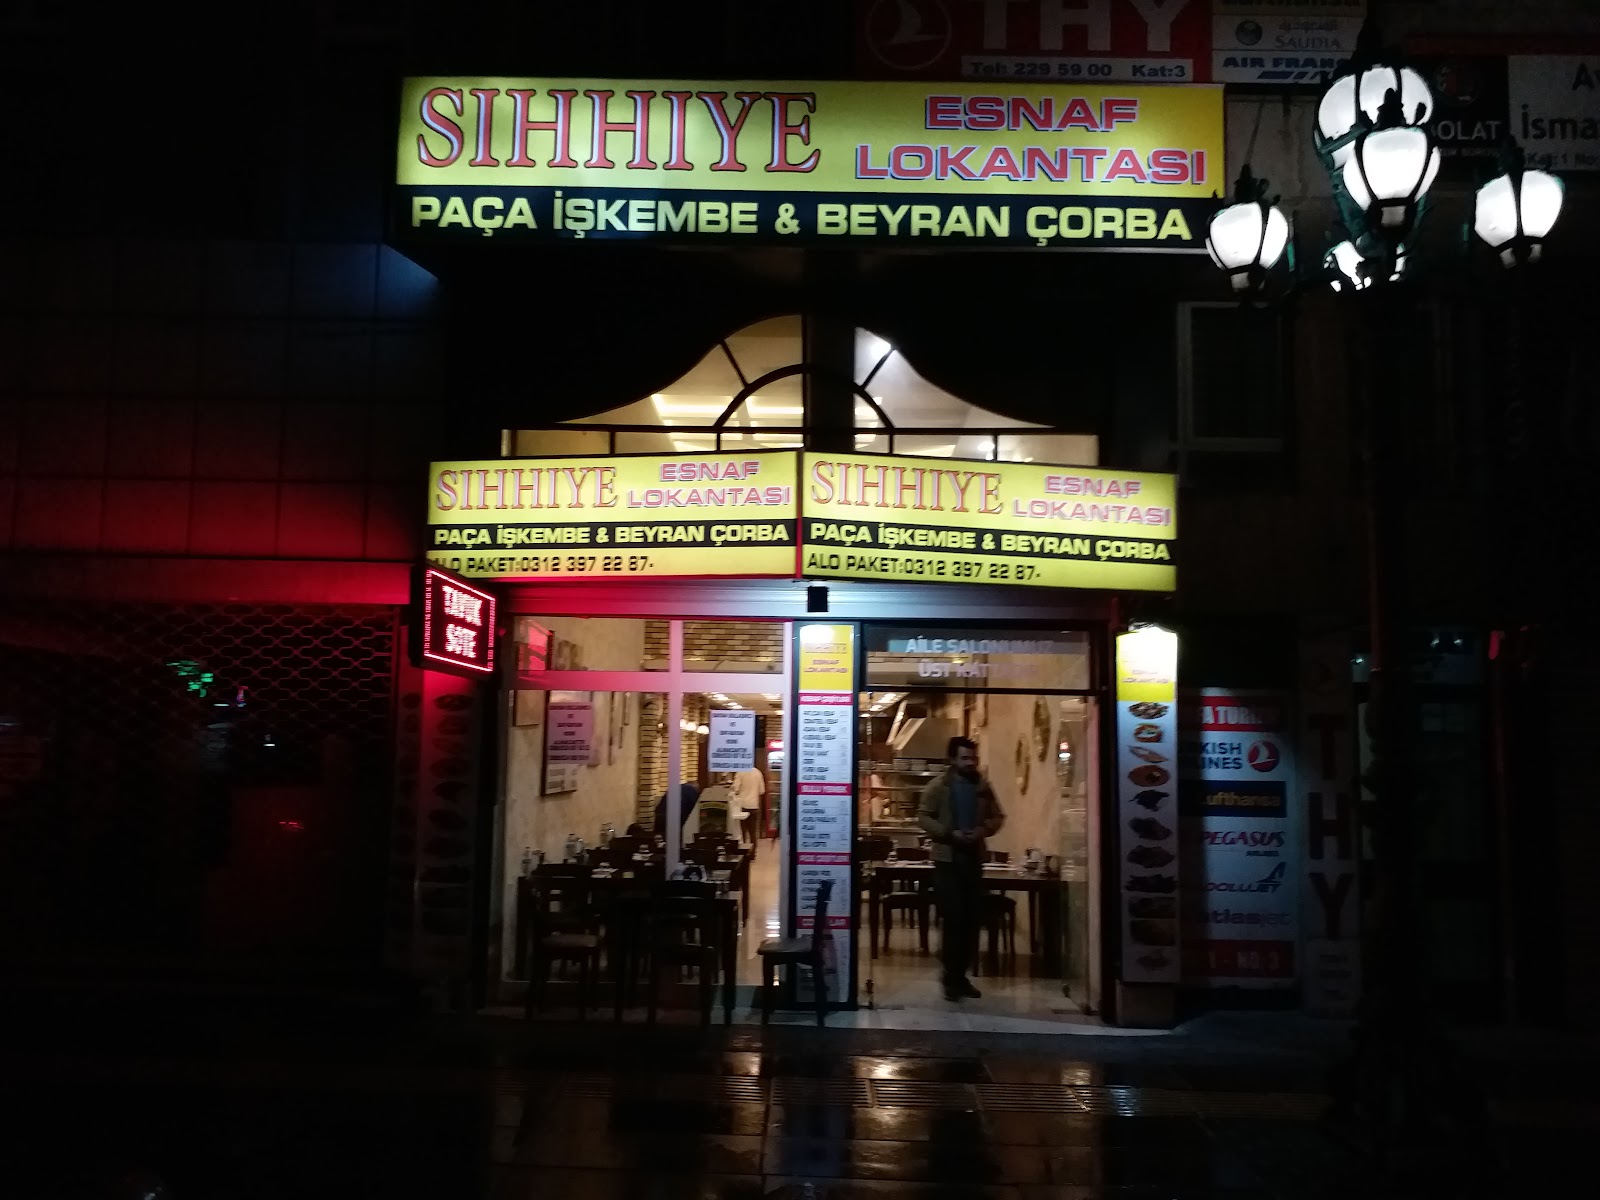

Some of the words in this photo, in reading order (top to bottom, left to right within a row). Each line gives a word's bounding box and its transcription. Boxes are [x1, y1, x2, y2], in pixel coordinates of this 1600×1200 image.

[968, 0, 1192, 51] THY
[1013, 62, 1051, 76] 229
[1057, 63, 1083, 76] 59
[1087, 63, 1113, 77] 00
[1131, 64, 1186, 78] Kat:3
[1222, 57, 1265, 68] AIR
[925, 95, 1139, 132] ESNAF
[417, 87, 821, 173] SIHHIYE
[855, 144, 1208, 185] LOKANTASI
[411, 196, 538, 238] PAÇA
[553, 190, 760, 239] İŞKEMBE
[774, 202, 801, 235] &
[816, 203, 1010, 239] BEYRAN
[1025, 206, 1193, 248] ÇORBA
[659, 460, 761, 482] ESNAF
[436, 467, 619, 511] SIHHIYE
[626, 486, 793, 509] LOKANTASI
[811, 460, 1003, 515] SIHHIYE
[1044, 475, 1142, 498] ESNAF
[1013, 498, 1172, 527] LOKANTASI
[434, 528, 492, 549] PAÇA
[496, 525, 591, 549] İŞKEMBE
[595, 527, 610, 545] &
[614, 525, 705, 544] BEYRAN
[710, 523, 790, 546] ÇORBA
[810, 522, 873, 547] PAÇA
[877, 522, 977, 549] İŞKEMBE
[981, 533, 996, 551] &
[1000, 534, 1091, 556] BEYRAN
[1095, 540, 1171, 561] ÇORBA
[567, 556, 597, 572] 397
[603, 556, 623, 572] 22
[806, 552, 841, 571] ALO
[952, 560, 984, 578] 397
[988, 562, 1010, 579] 22
